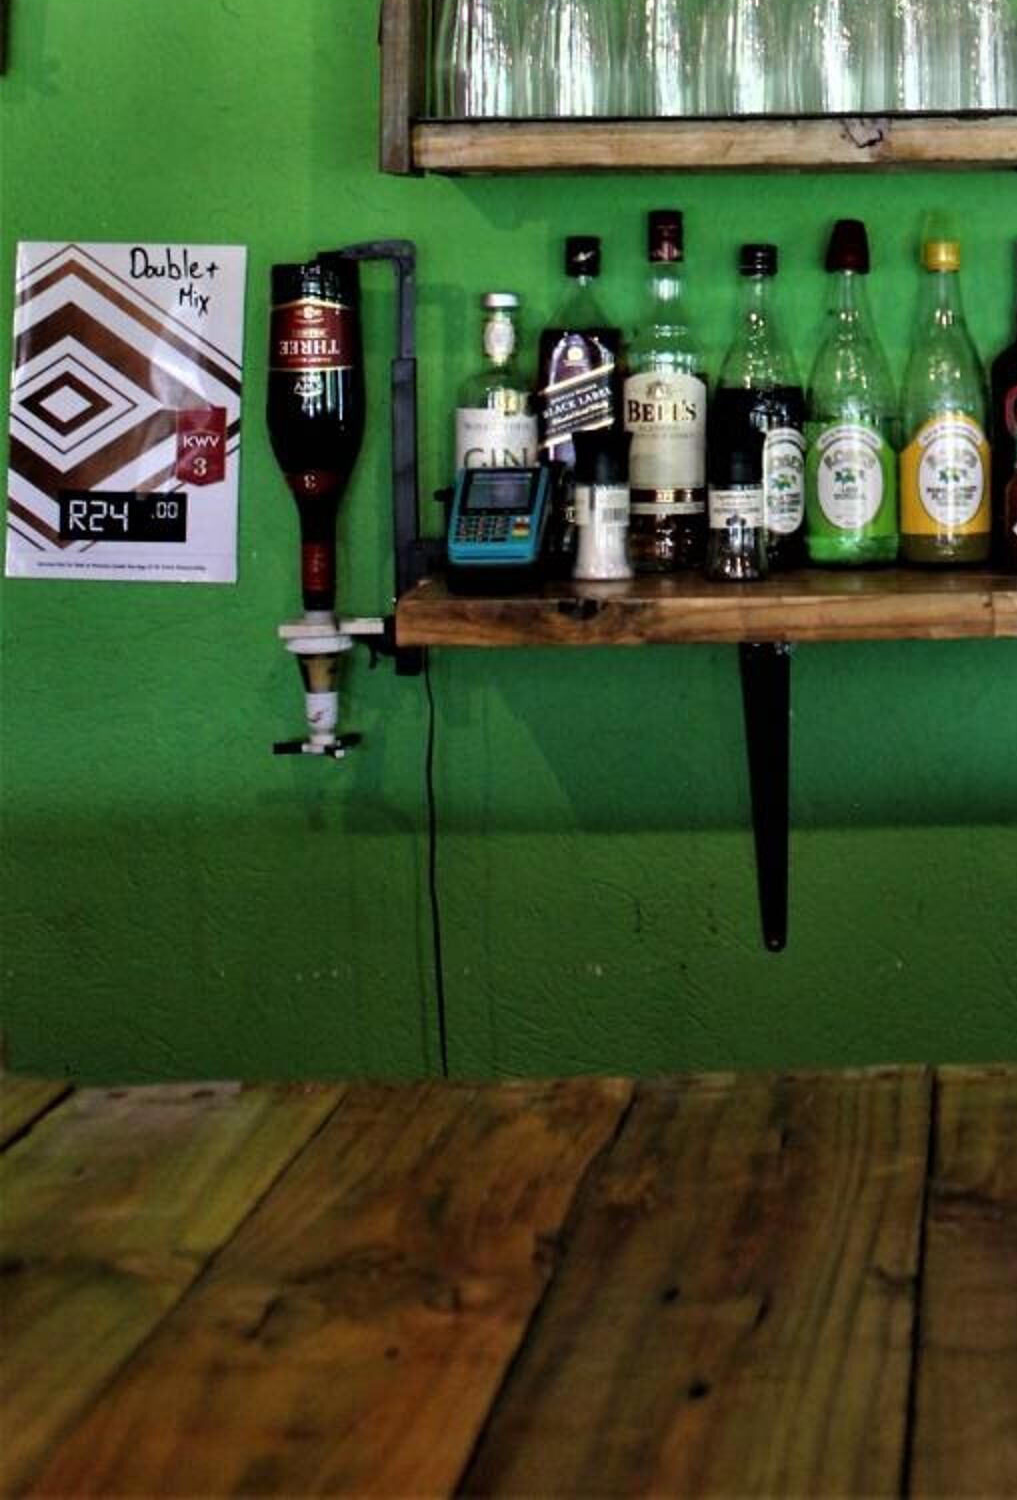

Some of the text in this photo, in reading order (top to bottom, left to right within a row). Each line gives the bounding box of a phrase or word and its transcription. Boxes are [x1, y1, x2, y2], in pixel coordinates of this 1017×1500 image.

[179, 282, 211, 319] Mix
[279, 339, 341, 355] THREE
[543, 399, 578, 420] BLACK
[577, 388, 612, 407] LABEL
[627, 400, 697, 423] BELL'S
[182, 435, 221, 449] KWV
[193, 457, 208, 477] 3
[463, 447, 530, 469] GIN
[303, 474, 317, 490] 3
[67, 500, 179, 532] R24 .00
